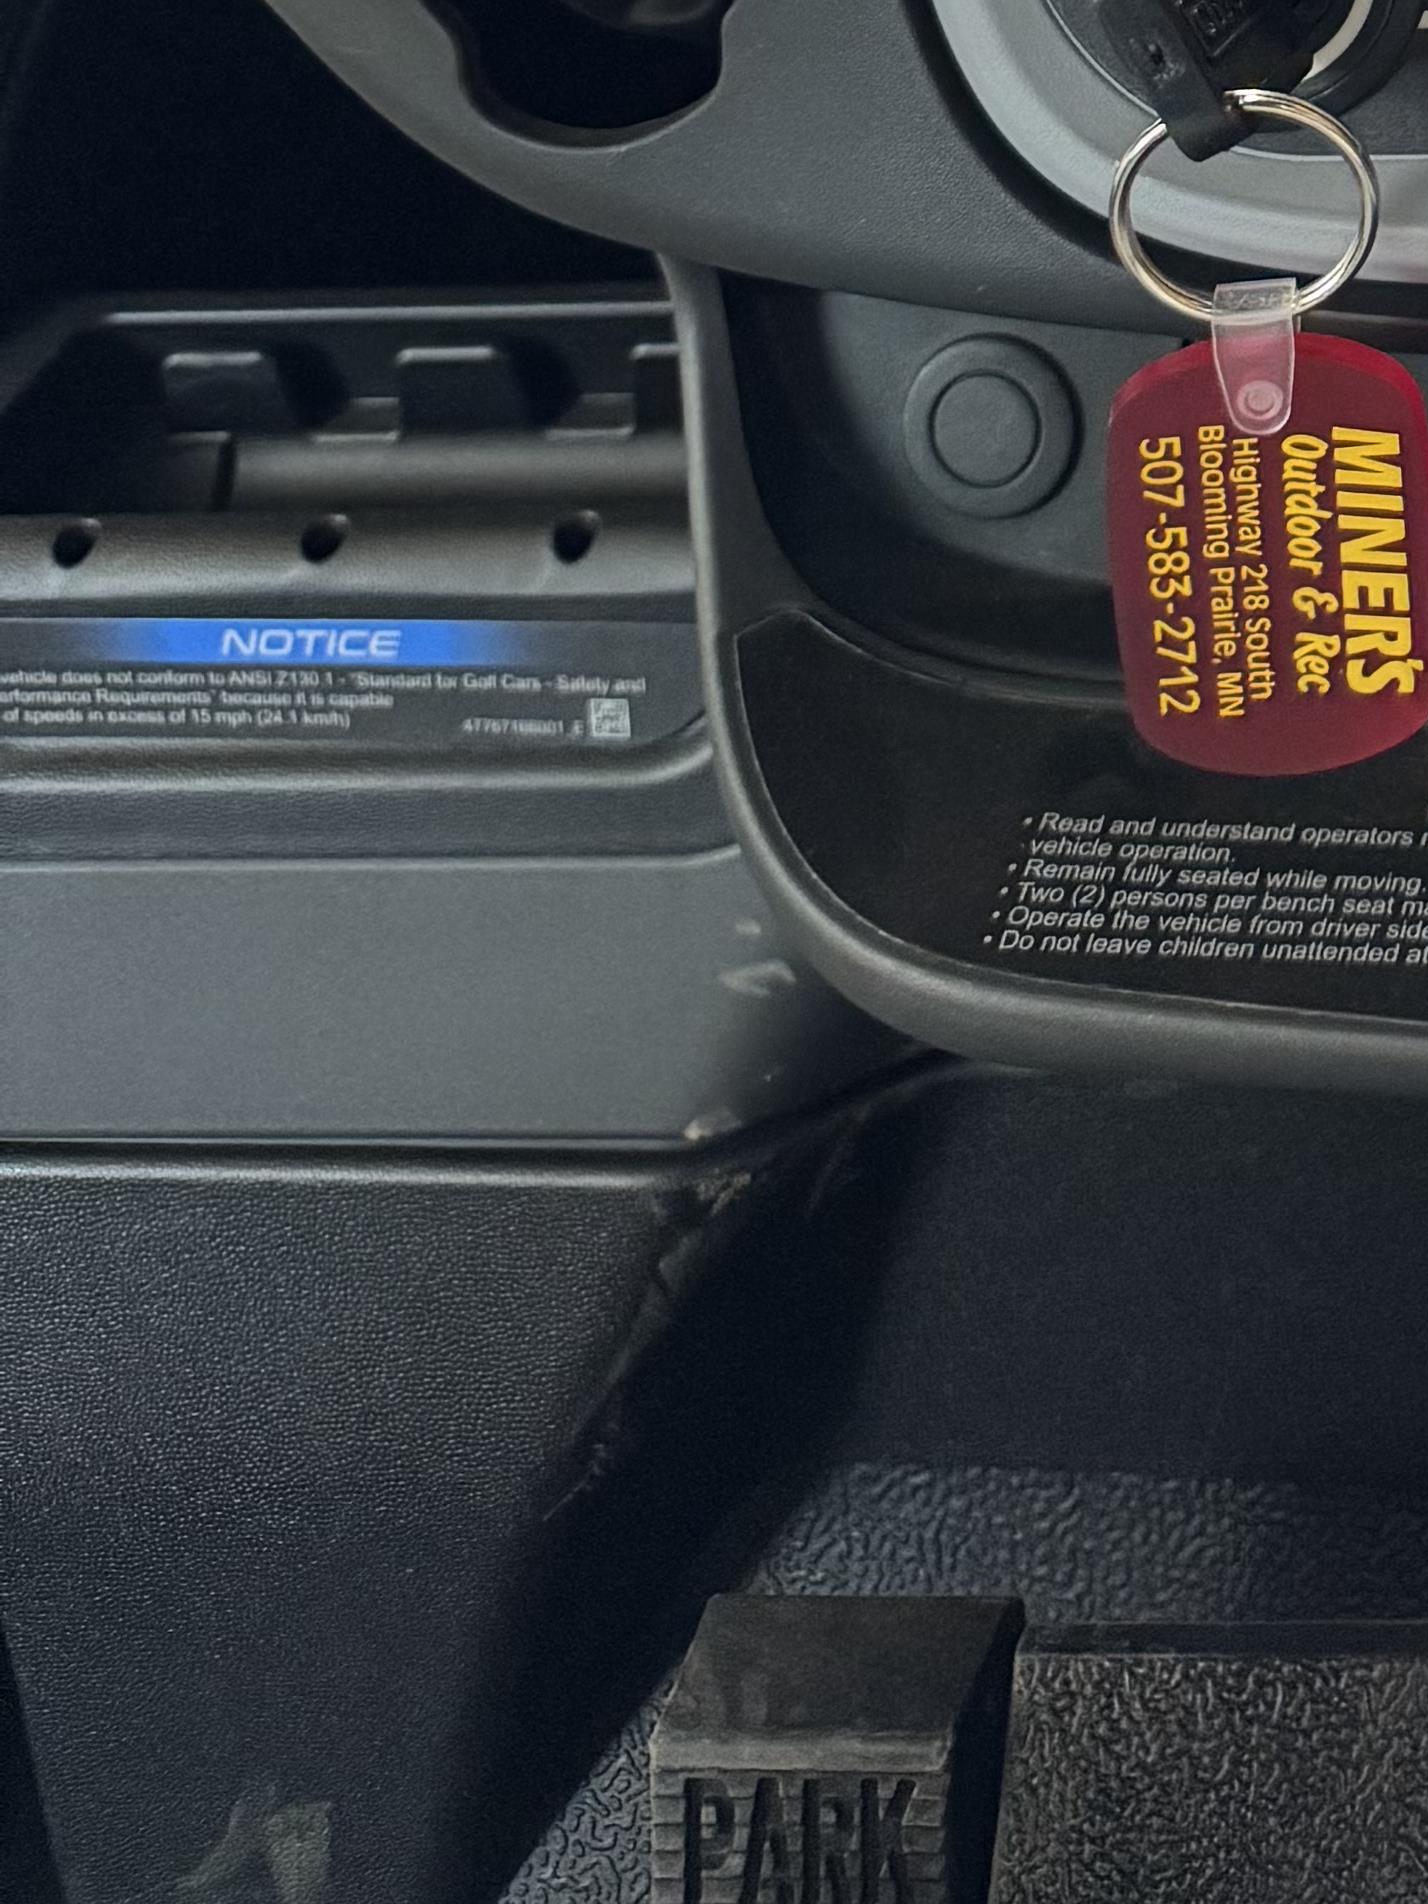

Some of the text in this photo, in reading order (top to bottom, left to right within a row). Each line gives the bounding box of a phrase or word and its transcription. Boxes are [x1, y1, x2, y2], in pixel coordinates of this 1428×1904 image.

[1138, 435, 1201, 717] 507-583-2712
[1197, 424, 1245, 719] Blooming Prairie, MN
[1231, 437, 1276, 701] Highway 218 South
[1281, 433, 1341, 696] Outdoor & Rec
[1331, 425, 1425, 696] MINER'S
[219, 629, 402, 659] NOTICE
[0, 670, 58, 685] vehicle
[61, 670, 102, 685] does
[105, 670, 134, 685] not
[136, 671, 205, 685] conform
[208, 671, 226, 686] to
[228, 672, 272, 687] ANSI
[436, 673, 458, 690] for
[463, 674, 497, 690] Golf
[502, 674, 542, 690] Cars
[556, 674, 610, 696] Safety
[614, 677, 647, 693] and
[0, 690, 91, 705] erformance
[221, 691, 292, 706] because
[296, 692, 307, 706] it
[310, 692, 326, 706] is
[329, 693, 395, 709] capable
[2, 708, 20, 723] of
[23, 709, 84, 726] speeds
[87, 710, 104, 723] in
[107, 712, 166, 724] excess
[169, 708, 186, 724] of
[190, 709, 212, 724] 15
[214, 712, 252, 727] mph
[303, 711, 350, 729] km/h)
[1038, 813, 1103, 835] Read
[1109, 816, 1155, 837] and
[1160, 818, 1295, 843] understand
[1300, 823, 1415, 852] operators
[1028, 837, 1237, 870] vehicle operation.
[1022, 860, 1428, 899] Remain fully seated while moving.
[683, 1777, 918, 1904] PARK
